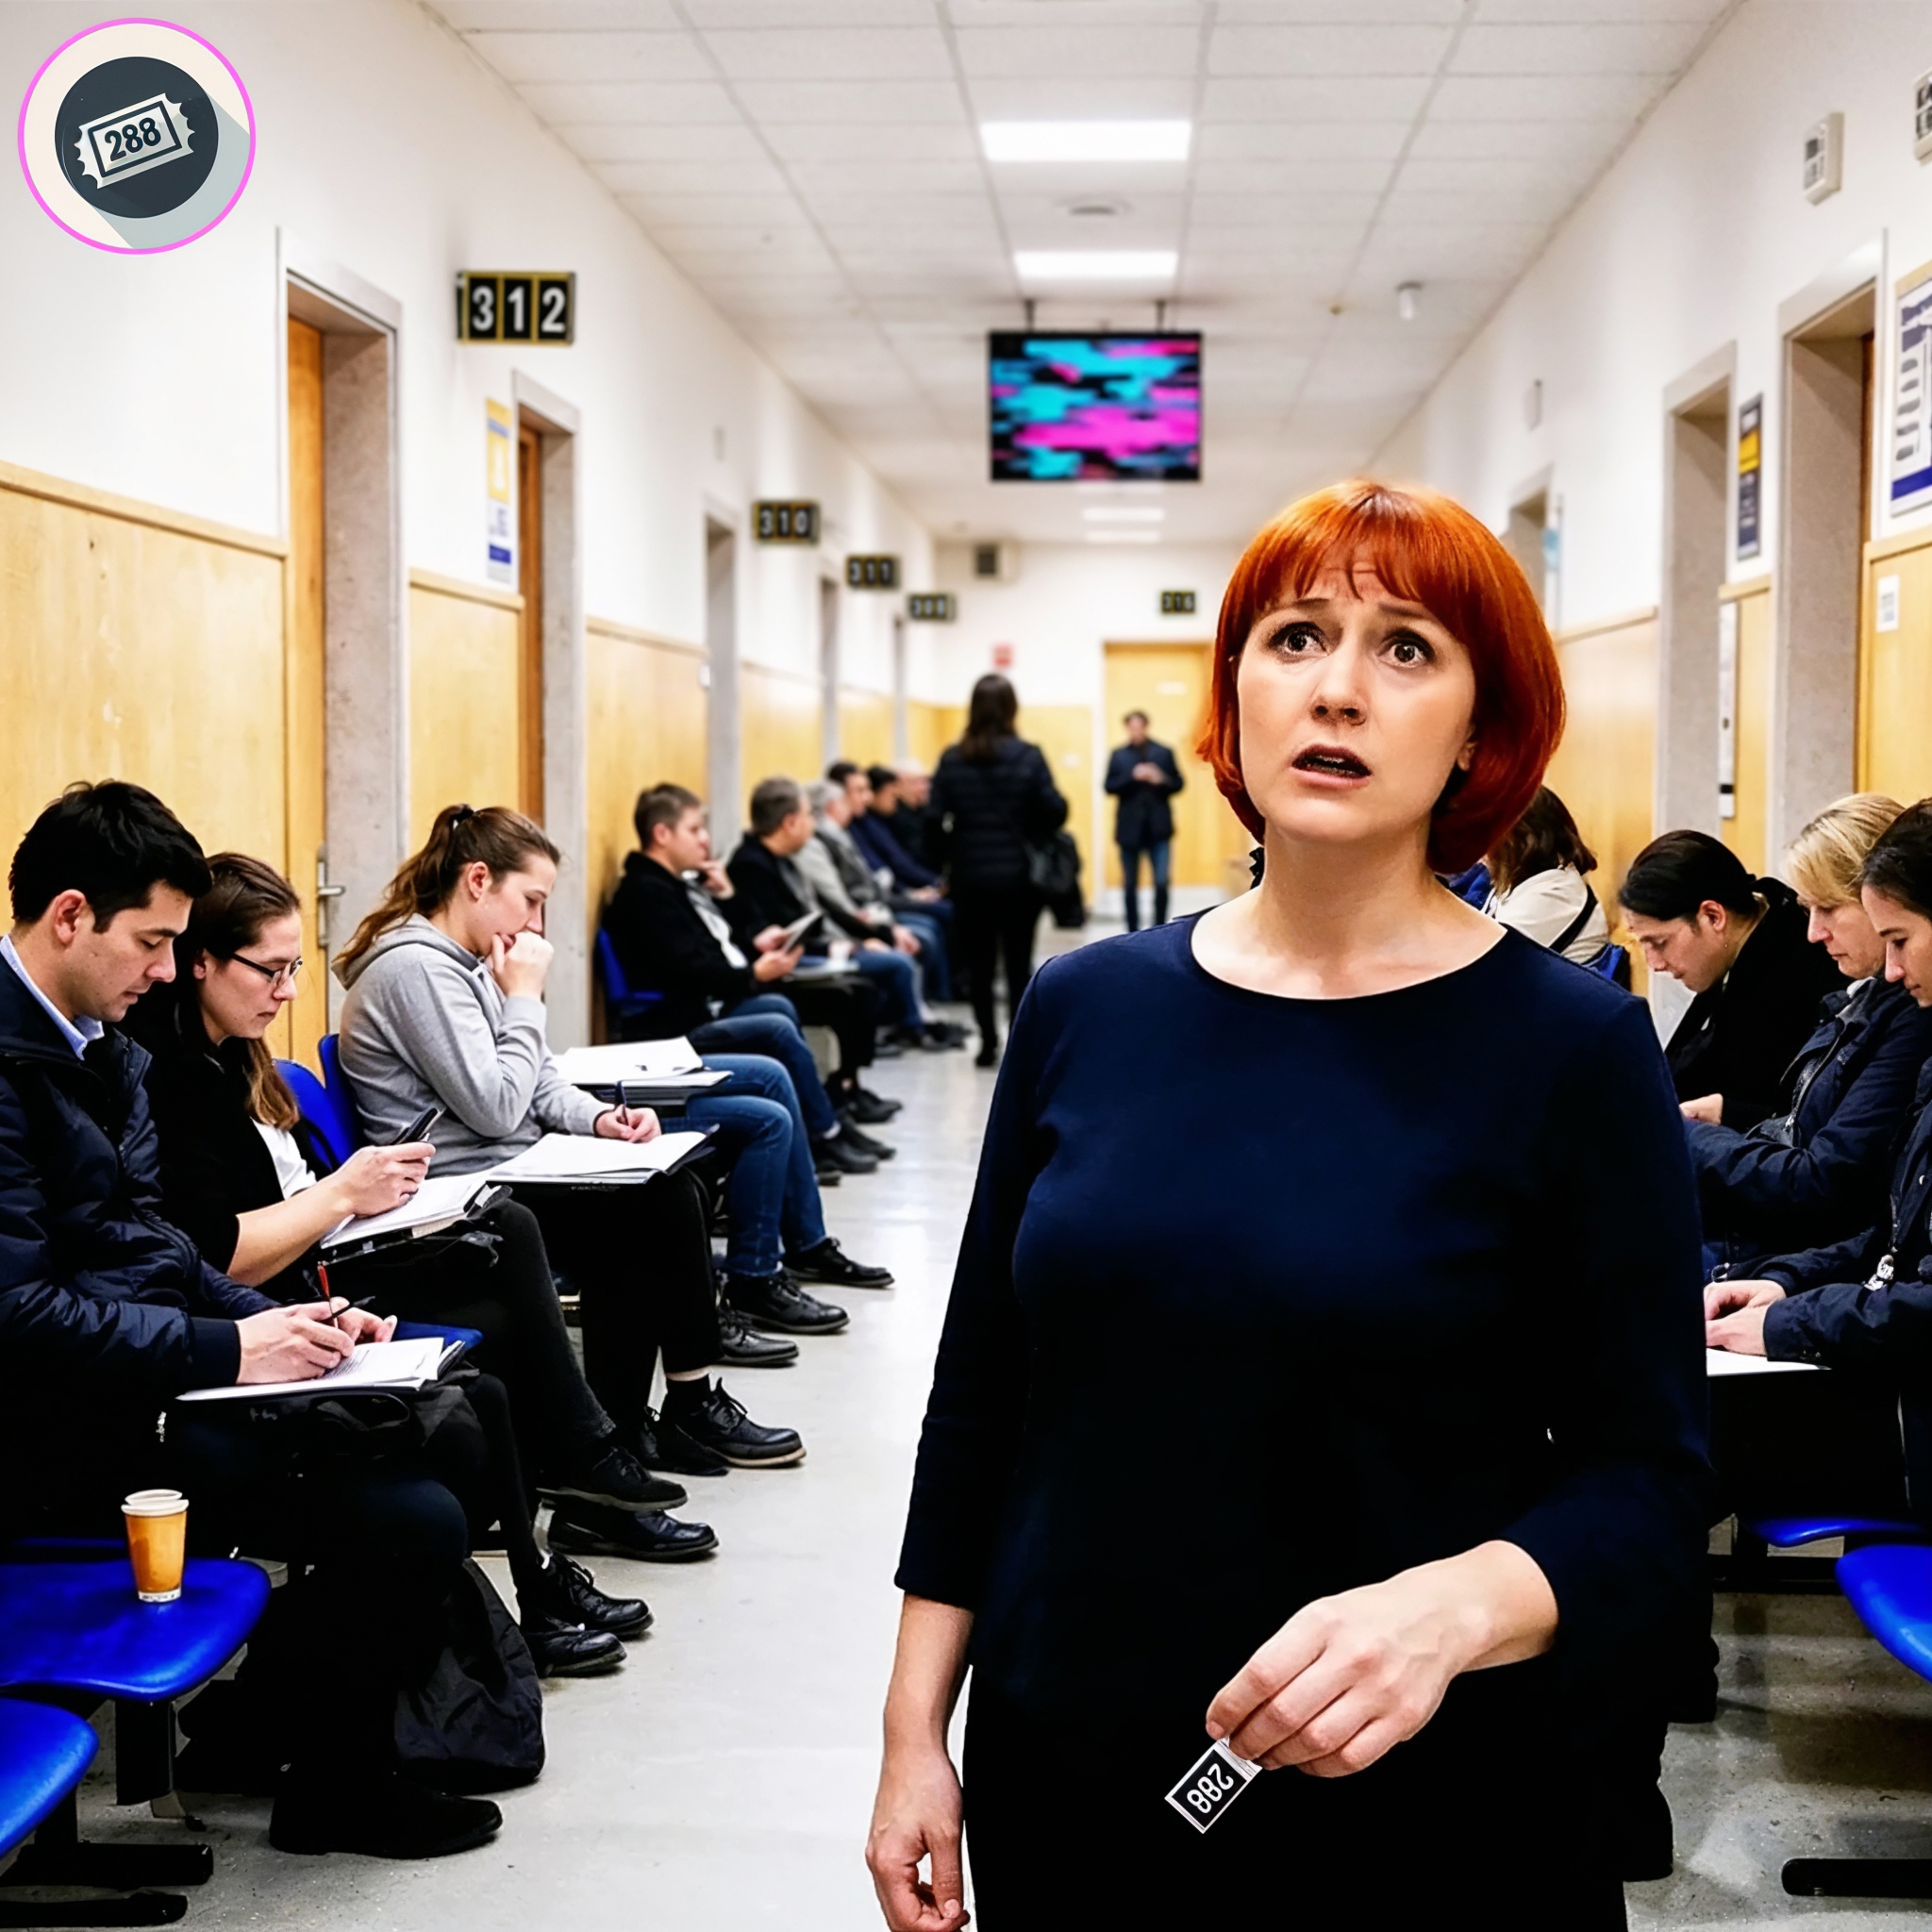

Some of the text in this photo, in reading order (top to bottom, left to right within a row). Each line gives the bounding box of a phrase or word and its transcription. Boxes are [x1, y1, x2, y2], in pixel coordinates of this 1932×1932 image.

[472, 285, 566, 333] 312
[759, 509, 809, 535] 310
[1187, 1762, 1234, 1813] 288
